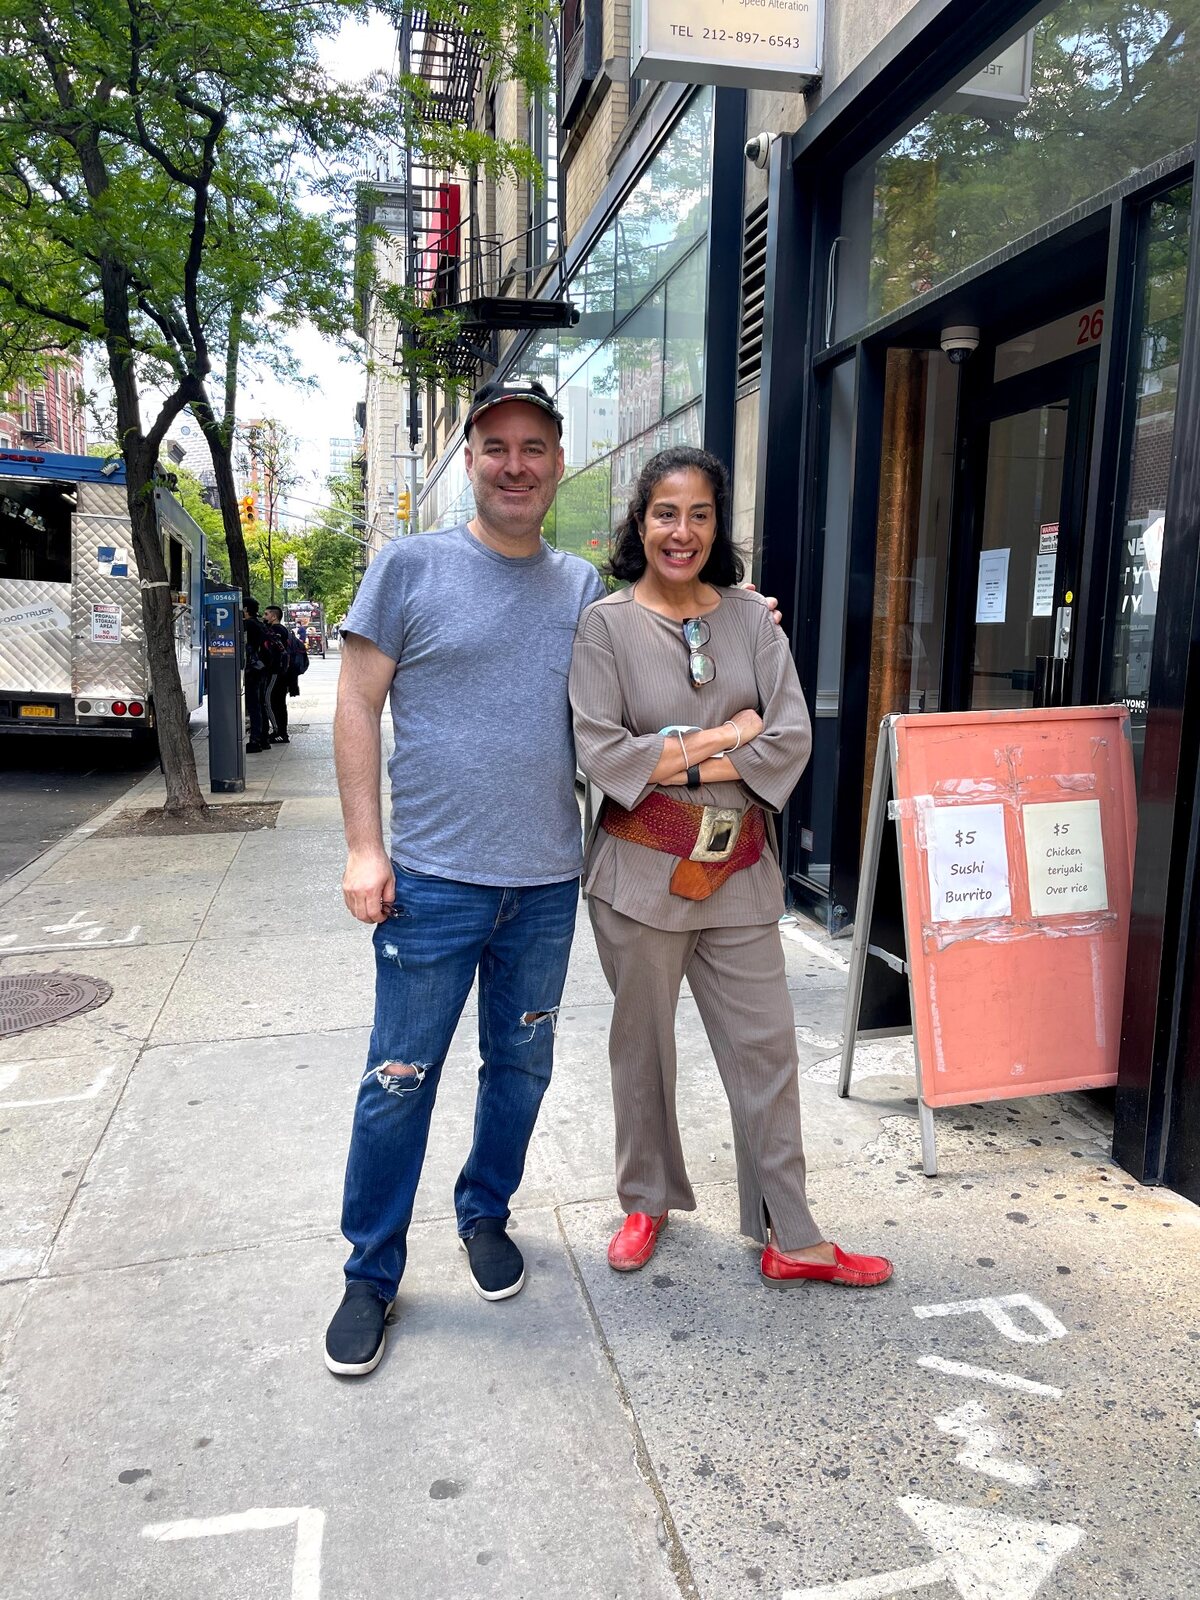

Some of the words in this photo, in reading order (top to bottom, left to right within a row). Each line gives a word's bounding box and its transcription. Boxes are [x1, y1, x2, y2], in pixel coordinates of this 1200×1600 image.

[768, 0, 809, 12] Alteration
[670, 25, 693, 38] TEL
[702, 28, 800, 48] 212-897-6543
[1077, 309, 1104, 345] 26
[0, 614, 24, 624] OOD
[24, 607, 54, 618] TRUCK
[216, 607, 229, 627] P
[1053, 823, 1070, 836] $5
[955, 829, 977, 847] $5
[1046, 846, 1082, 857] Chicken
[950, 860, 985, 875] Sushi
[1047, 863, 1083, 876] teriyaki
[945, 887, 992, 903] Burrito
[1046, 886, 1068, 895] Over
[1071, 883, 1088, 893] rice
